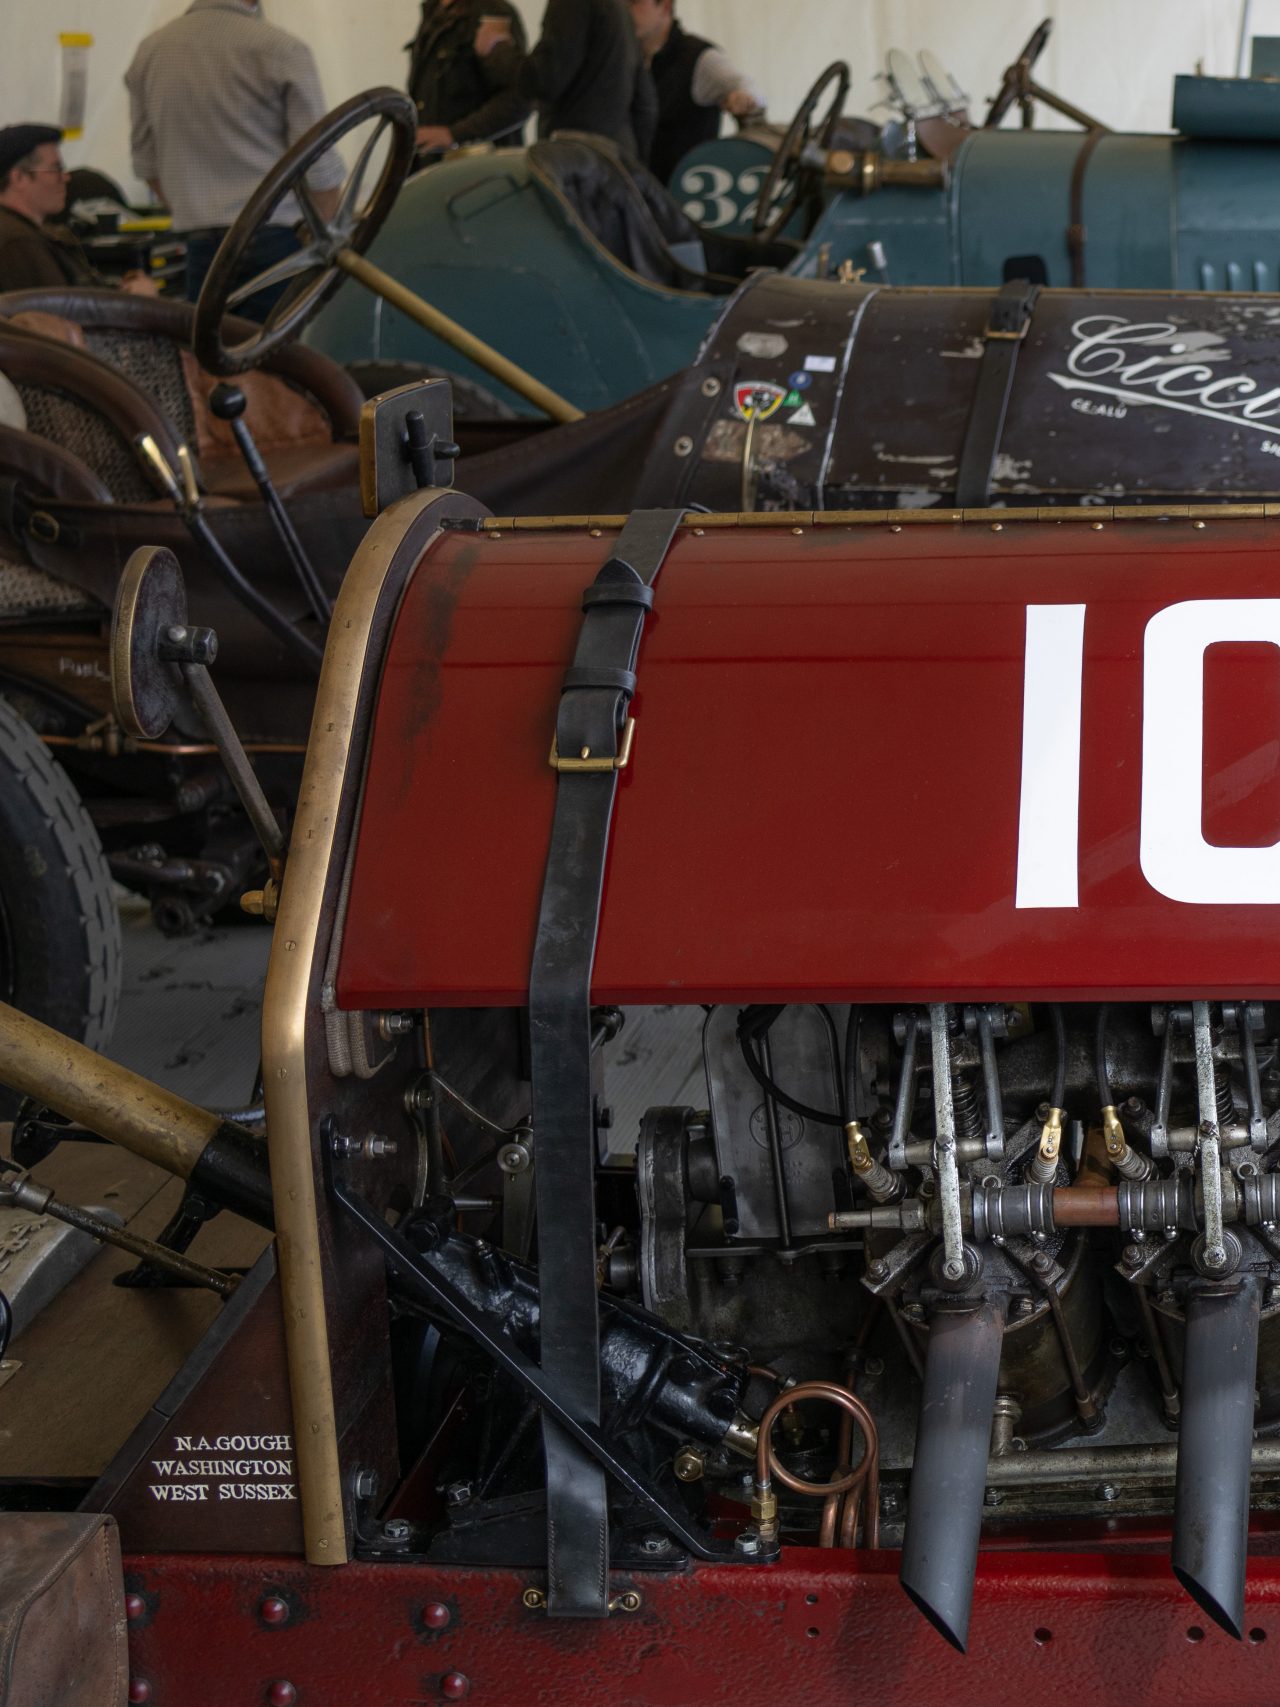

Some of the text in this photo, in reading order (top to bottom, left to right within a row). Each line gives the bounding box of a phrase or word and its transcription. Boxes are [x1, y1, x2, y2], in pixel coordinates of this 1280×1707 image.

[152, 1460, 293, 1476] WASHINGTON
[149, 1484, 297, 1500] WEST SUSSEX
